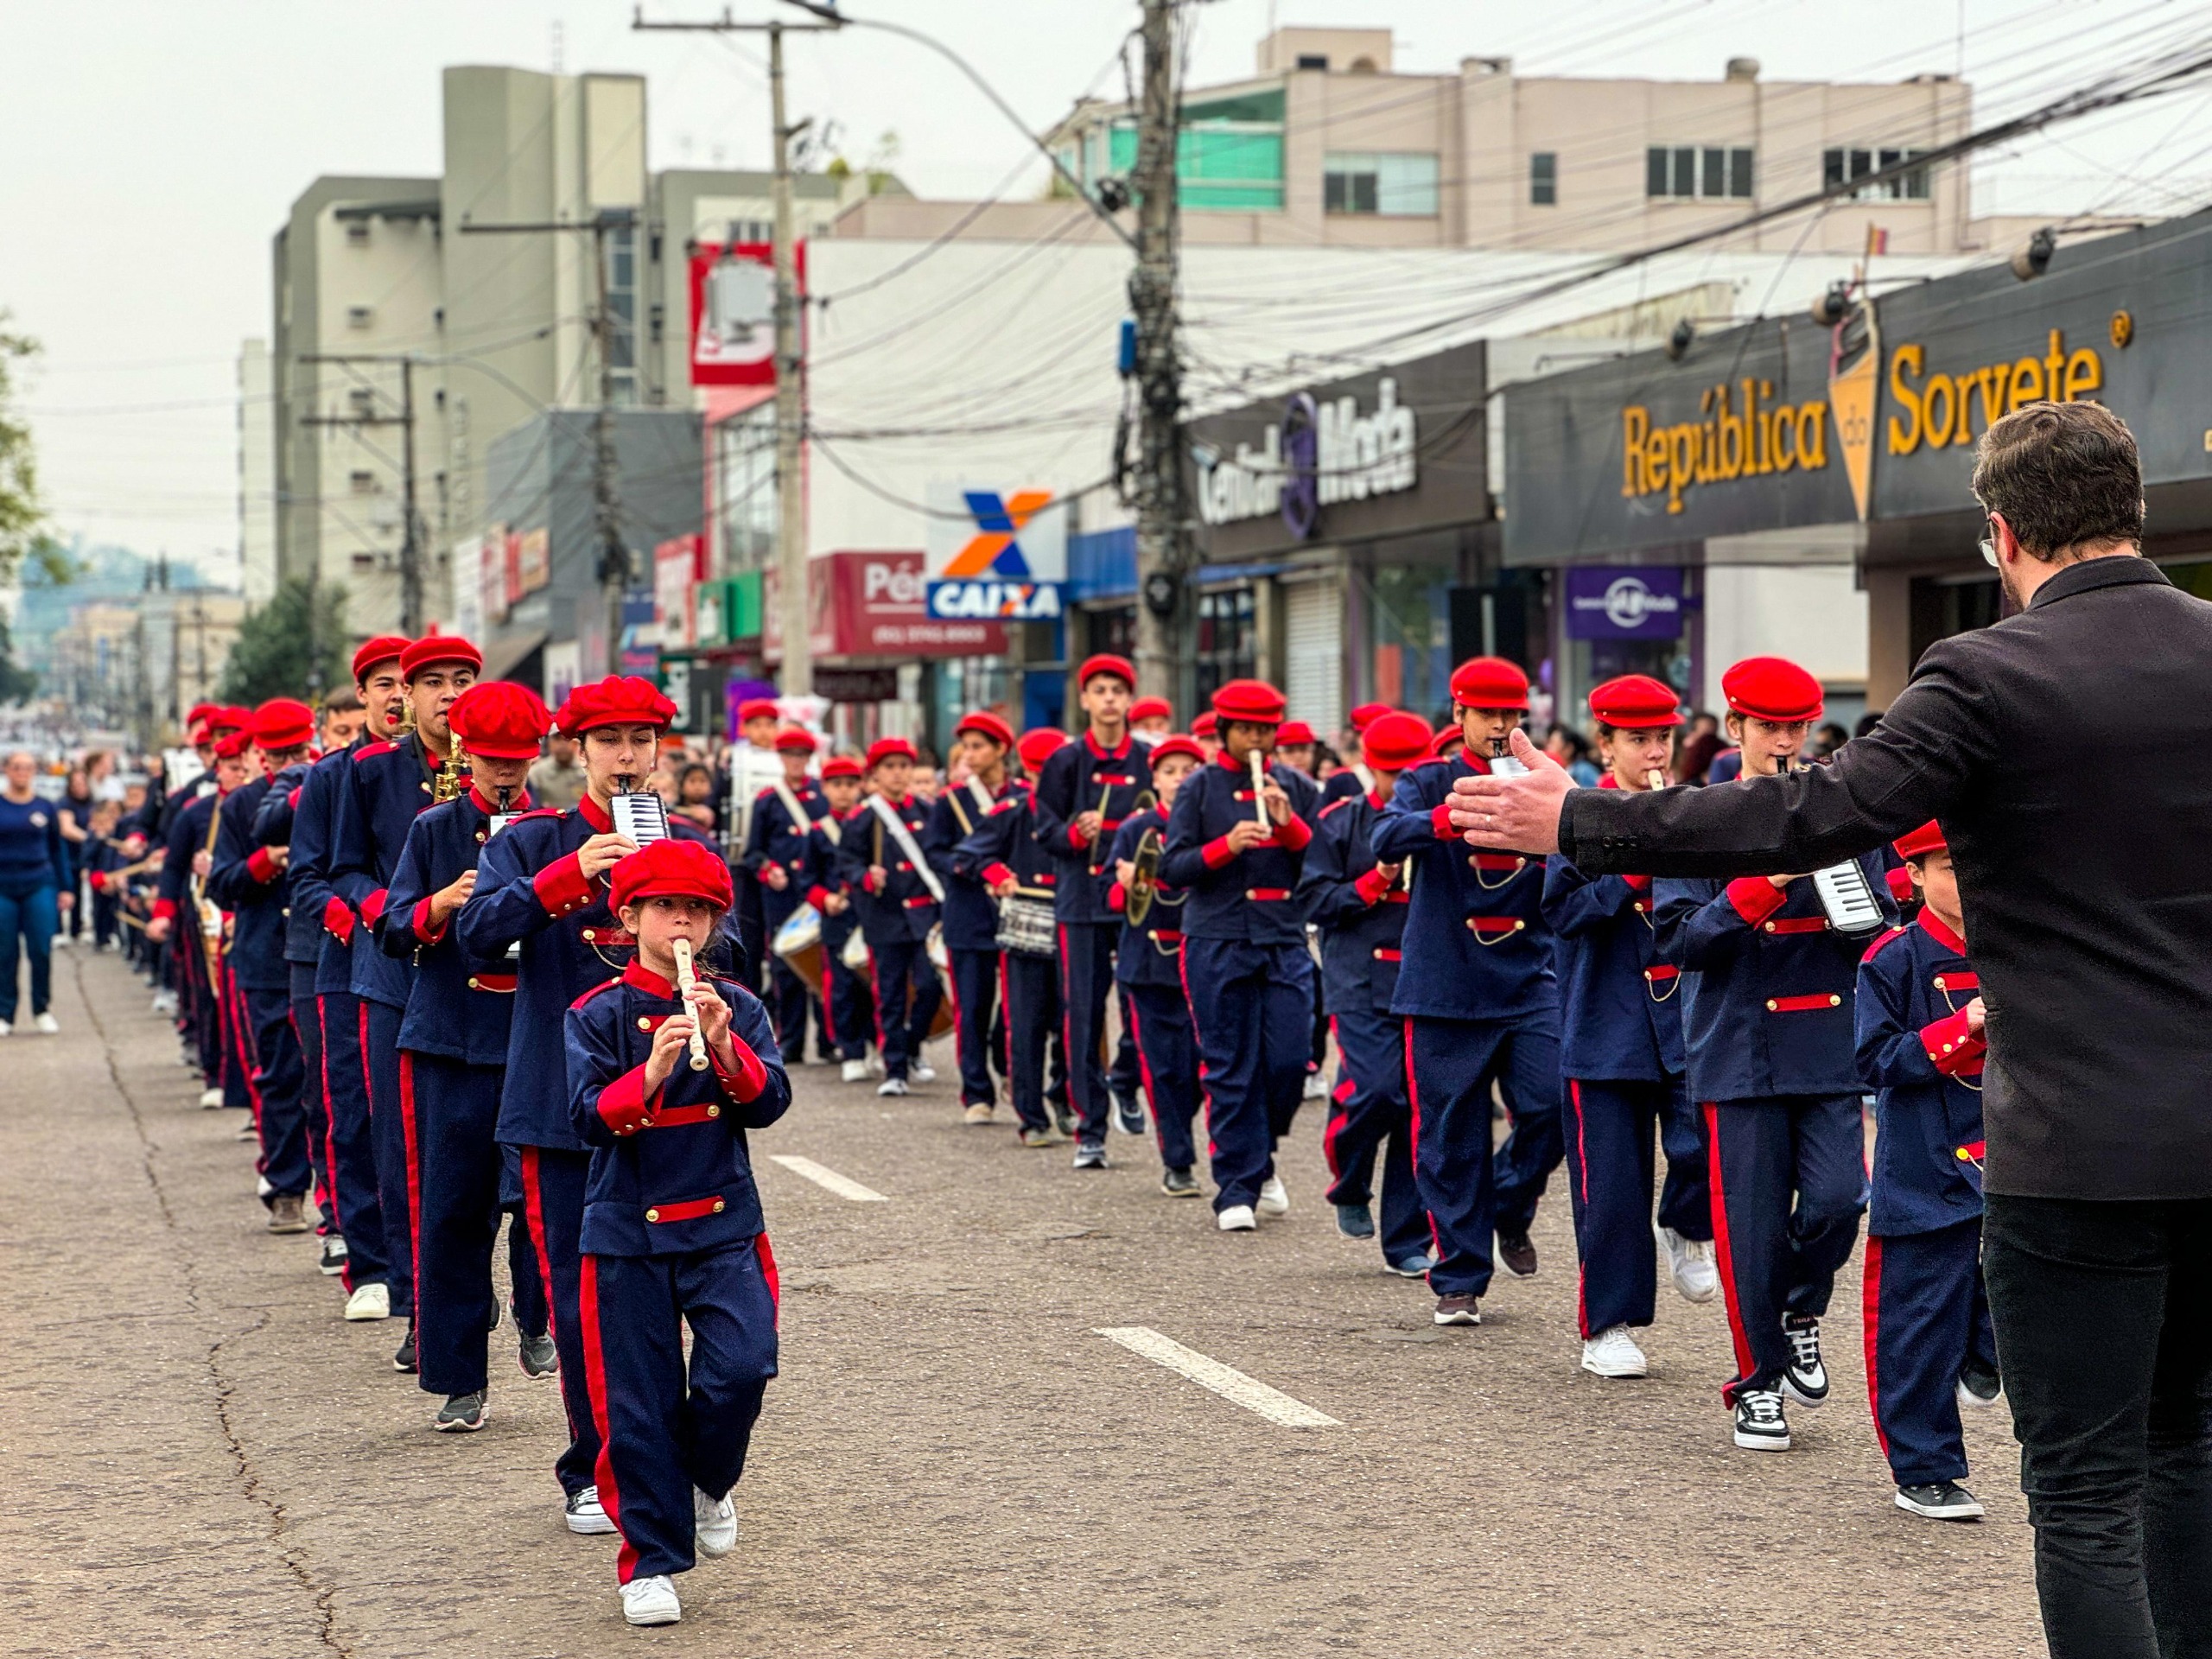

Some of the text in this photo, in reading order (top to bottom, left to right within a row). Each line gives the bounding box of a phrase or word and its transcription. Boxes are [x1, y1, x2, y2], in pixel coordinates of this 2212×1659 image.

[1621, 377, 1827, 515] República
[1888, 327, 2102, 456] Sorvete
[933, 582, 1060, 617] CAIXA
